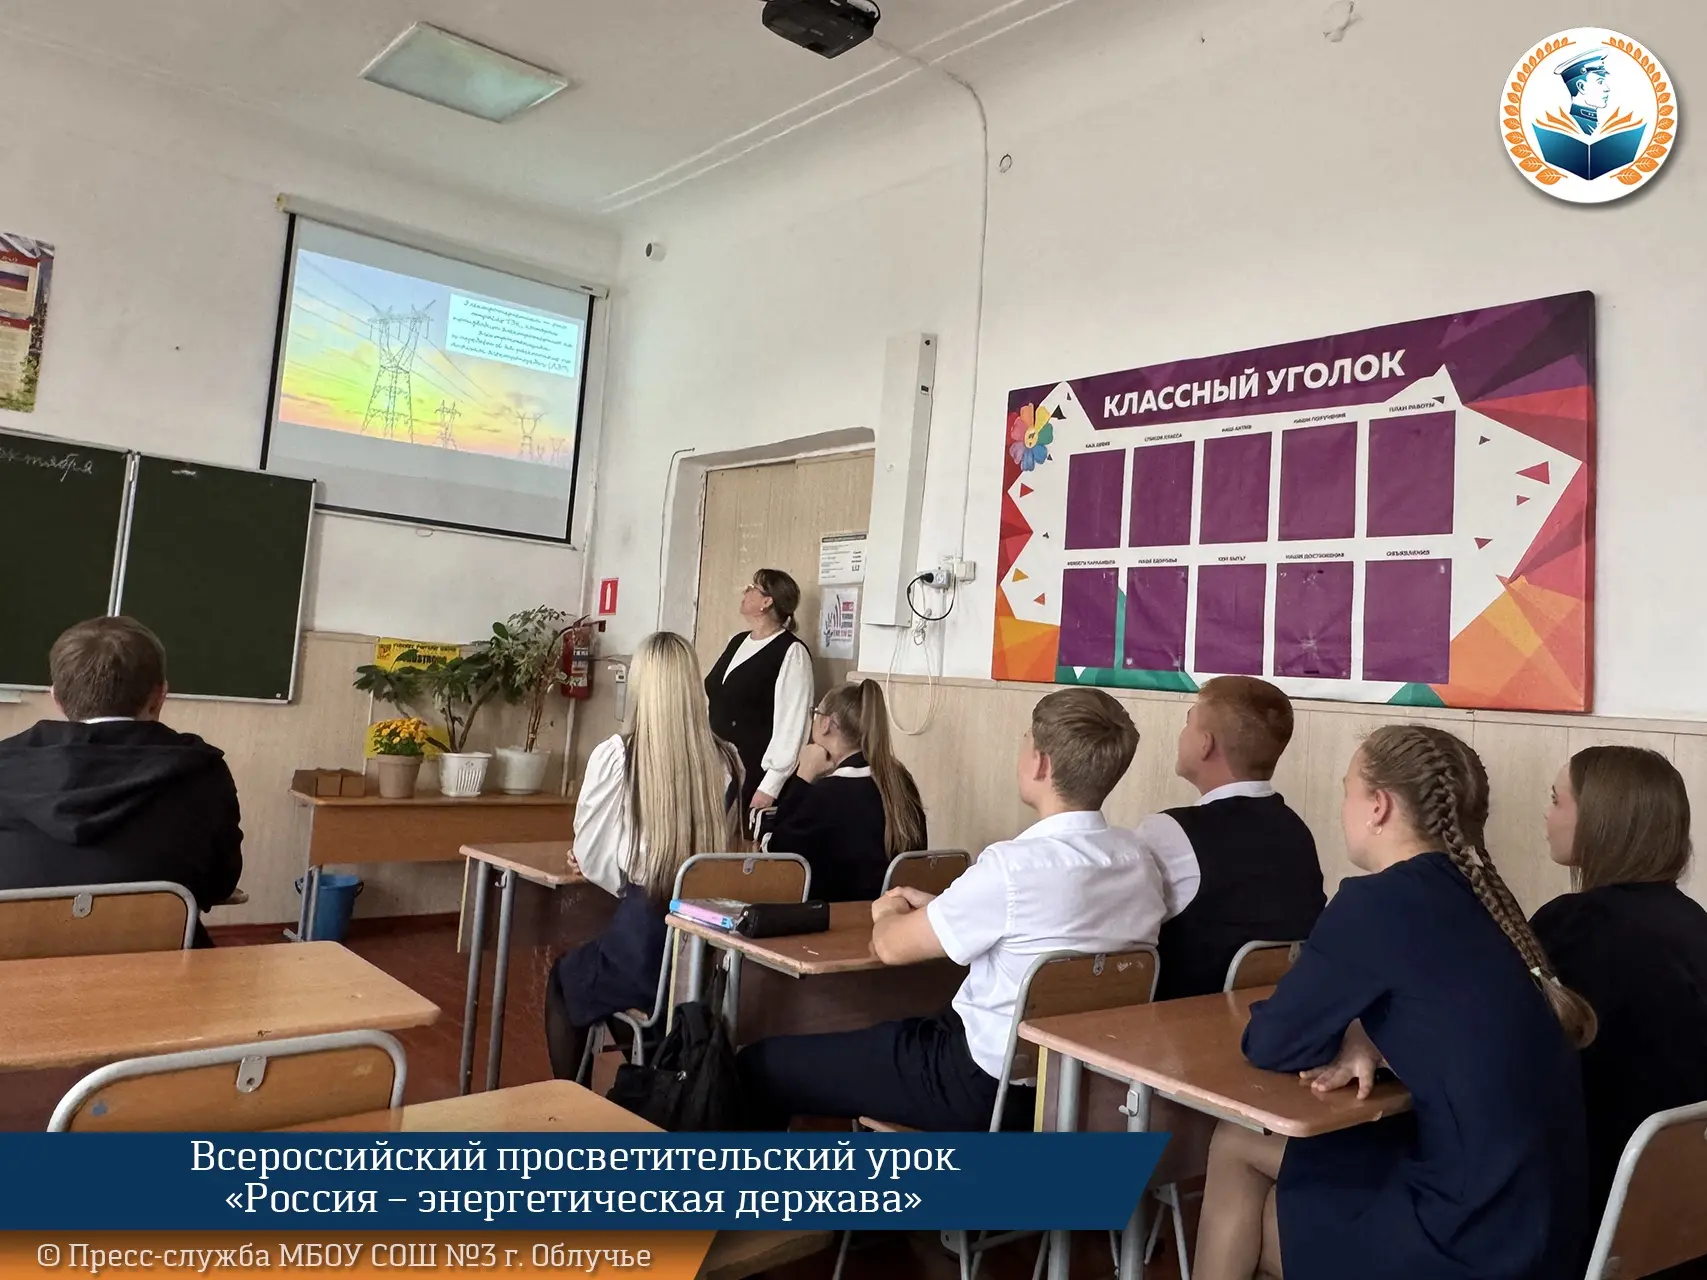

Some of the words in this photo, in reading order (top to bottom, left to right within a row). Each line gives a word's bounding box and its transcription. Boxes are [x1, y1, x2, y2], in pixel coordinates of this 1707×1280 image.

[1103, 367, 1259, 419] КЛАССНЫЙ
[1267, 349, 1406, 396] УГОЛОК
[1408, 402, 1435, 410] РАБОТЫ
